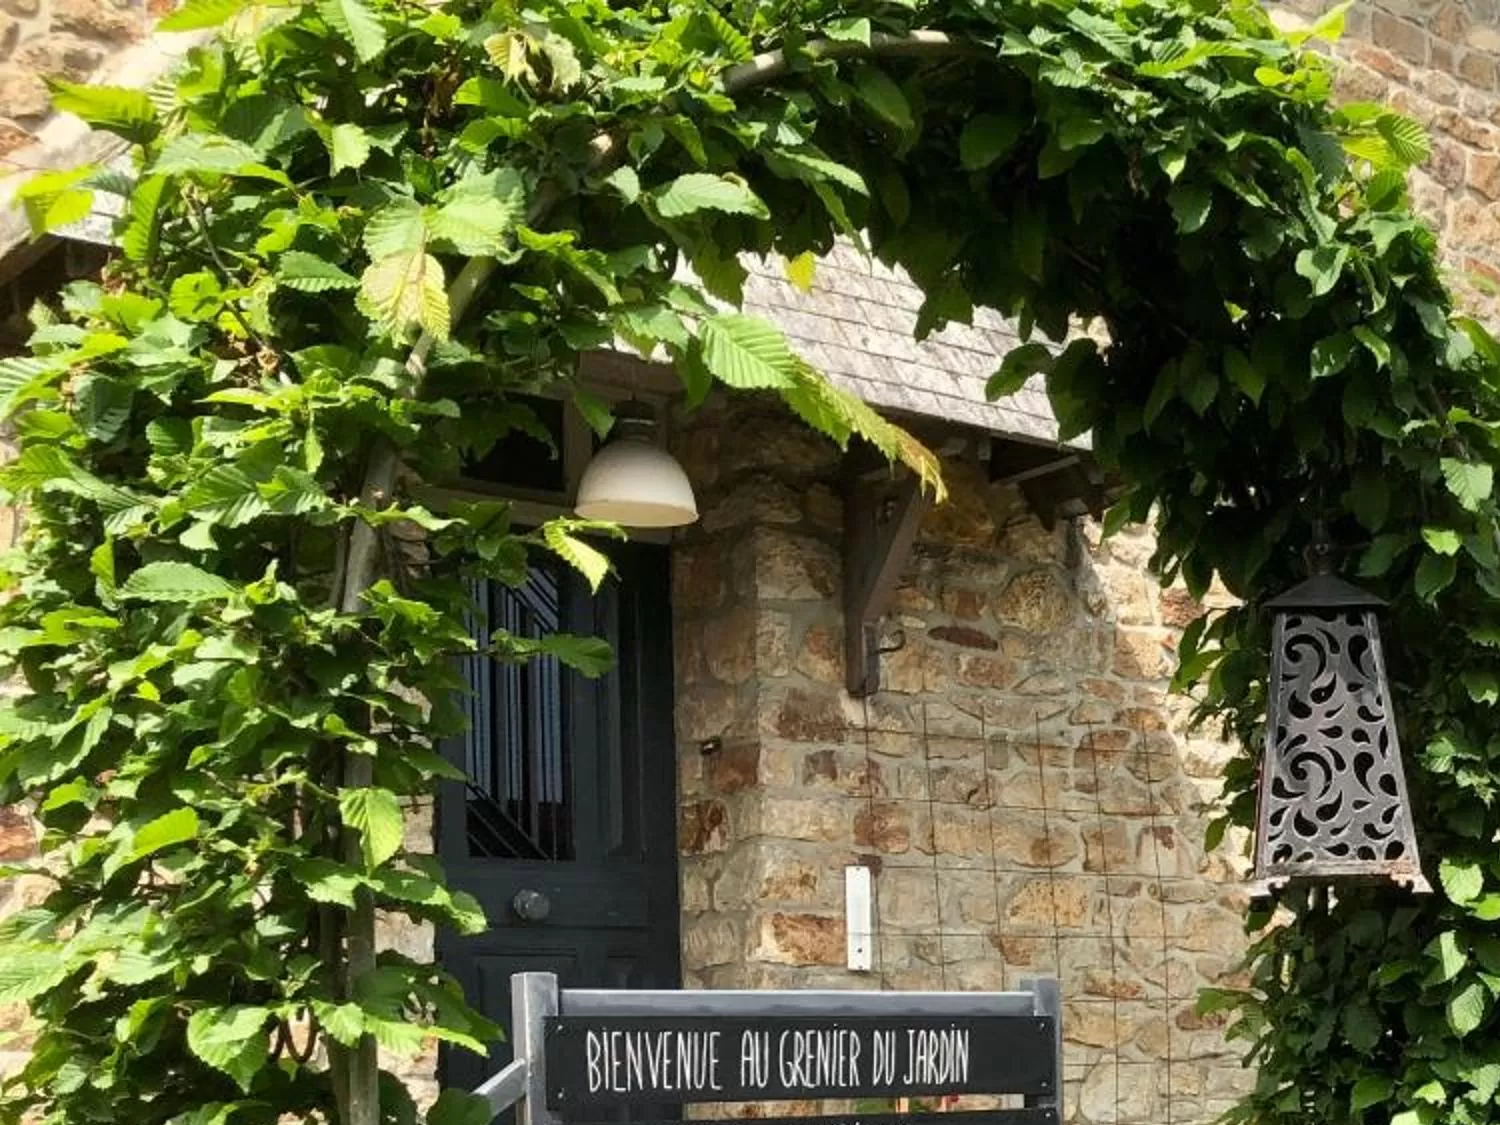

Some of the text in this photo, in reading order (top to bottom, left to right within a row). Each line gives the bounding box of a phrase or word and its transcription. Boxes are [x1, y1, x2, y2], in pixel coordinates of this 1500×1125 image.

[586, 1023, 969, 1093] BIENVENUE AU GRENIER DU JARDIN
